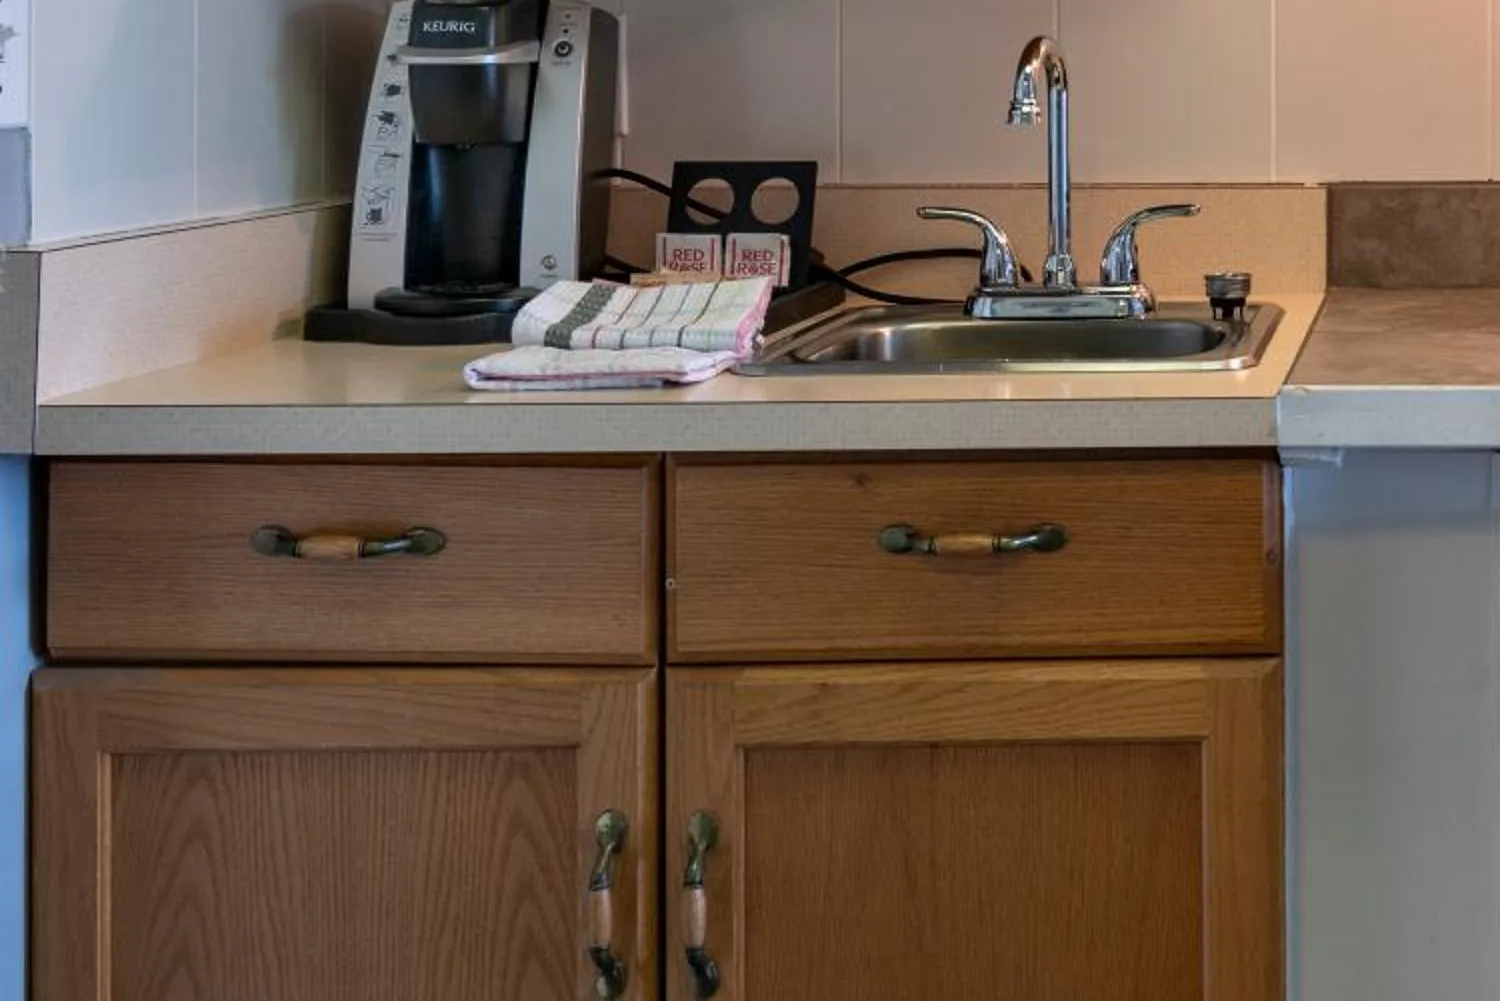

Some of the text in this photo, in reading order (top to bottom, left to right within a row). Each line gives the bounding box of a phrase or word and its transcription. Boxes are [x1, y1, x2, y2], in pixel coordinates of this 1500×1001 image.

[423, 22, 476, 32] KEURIG
[673, 248, 705, 261] RED
[741, 249, 774, 261] RED
[737, 262, 777, 275] ROSE
